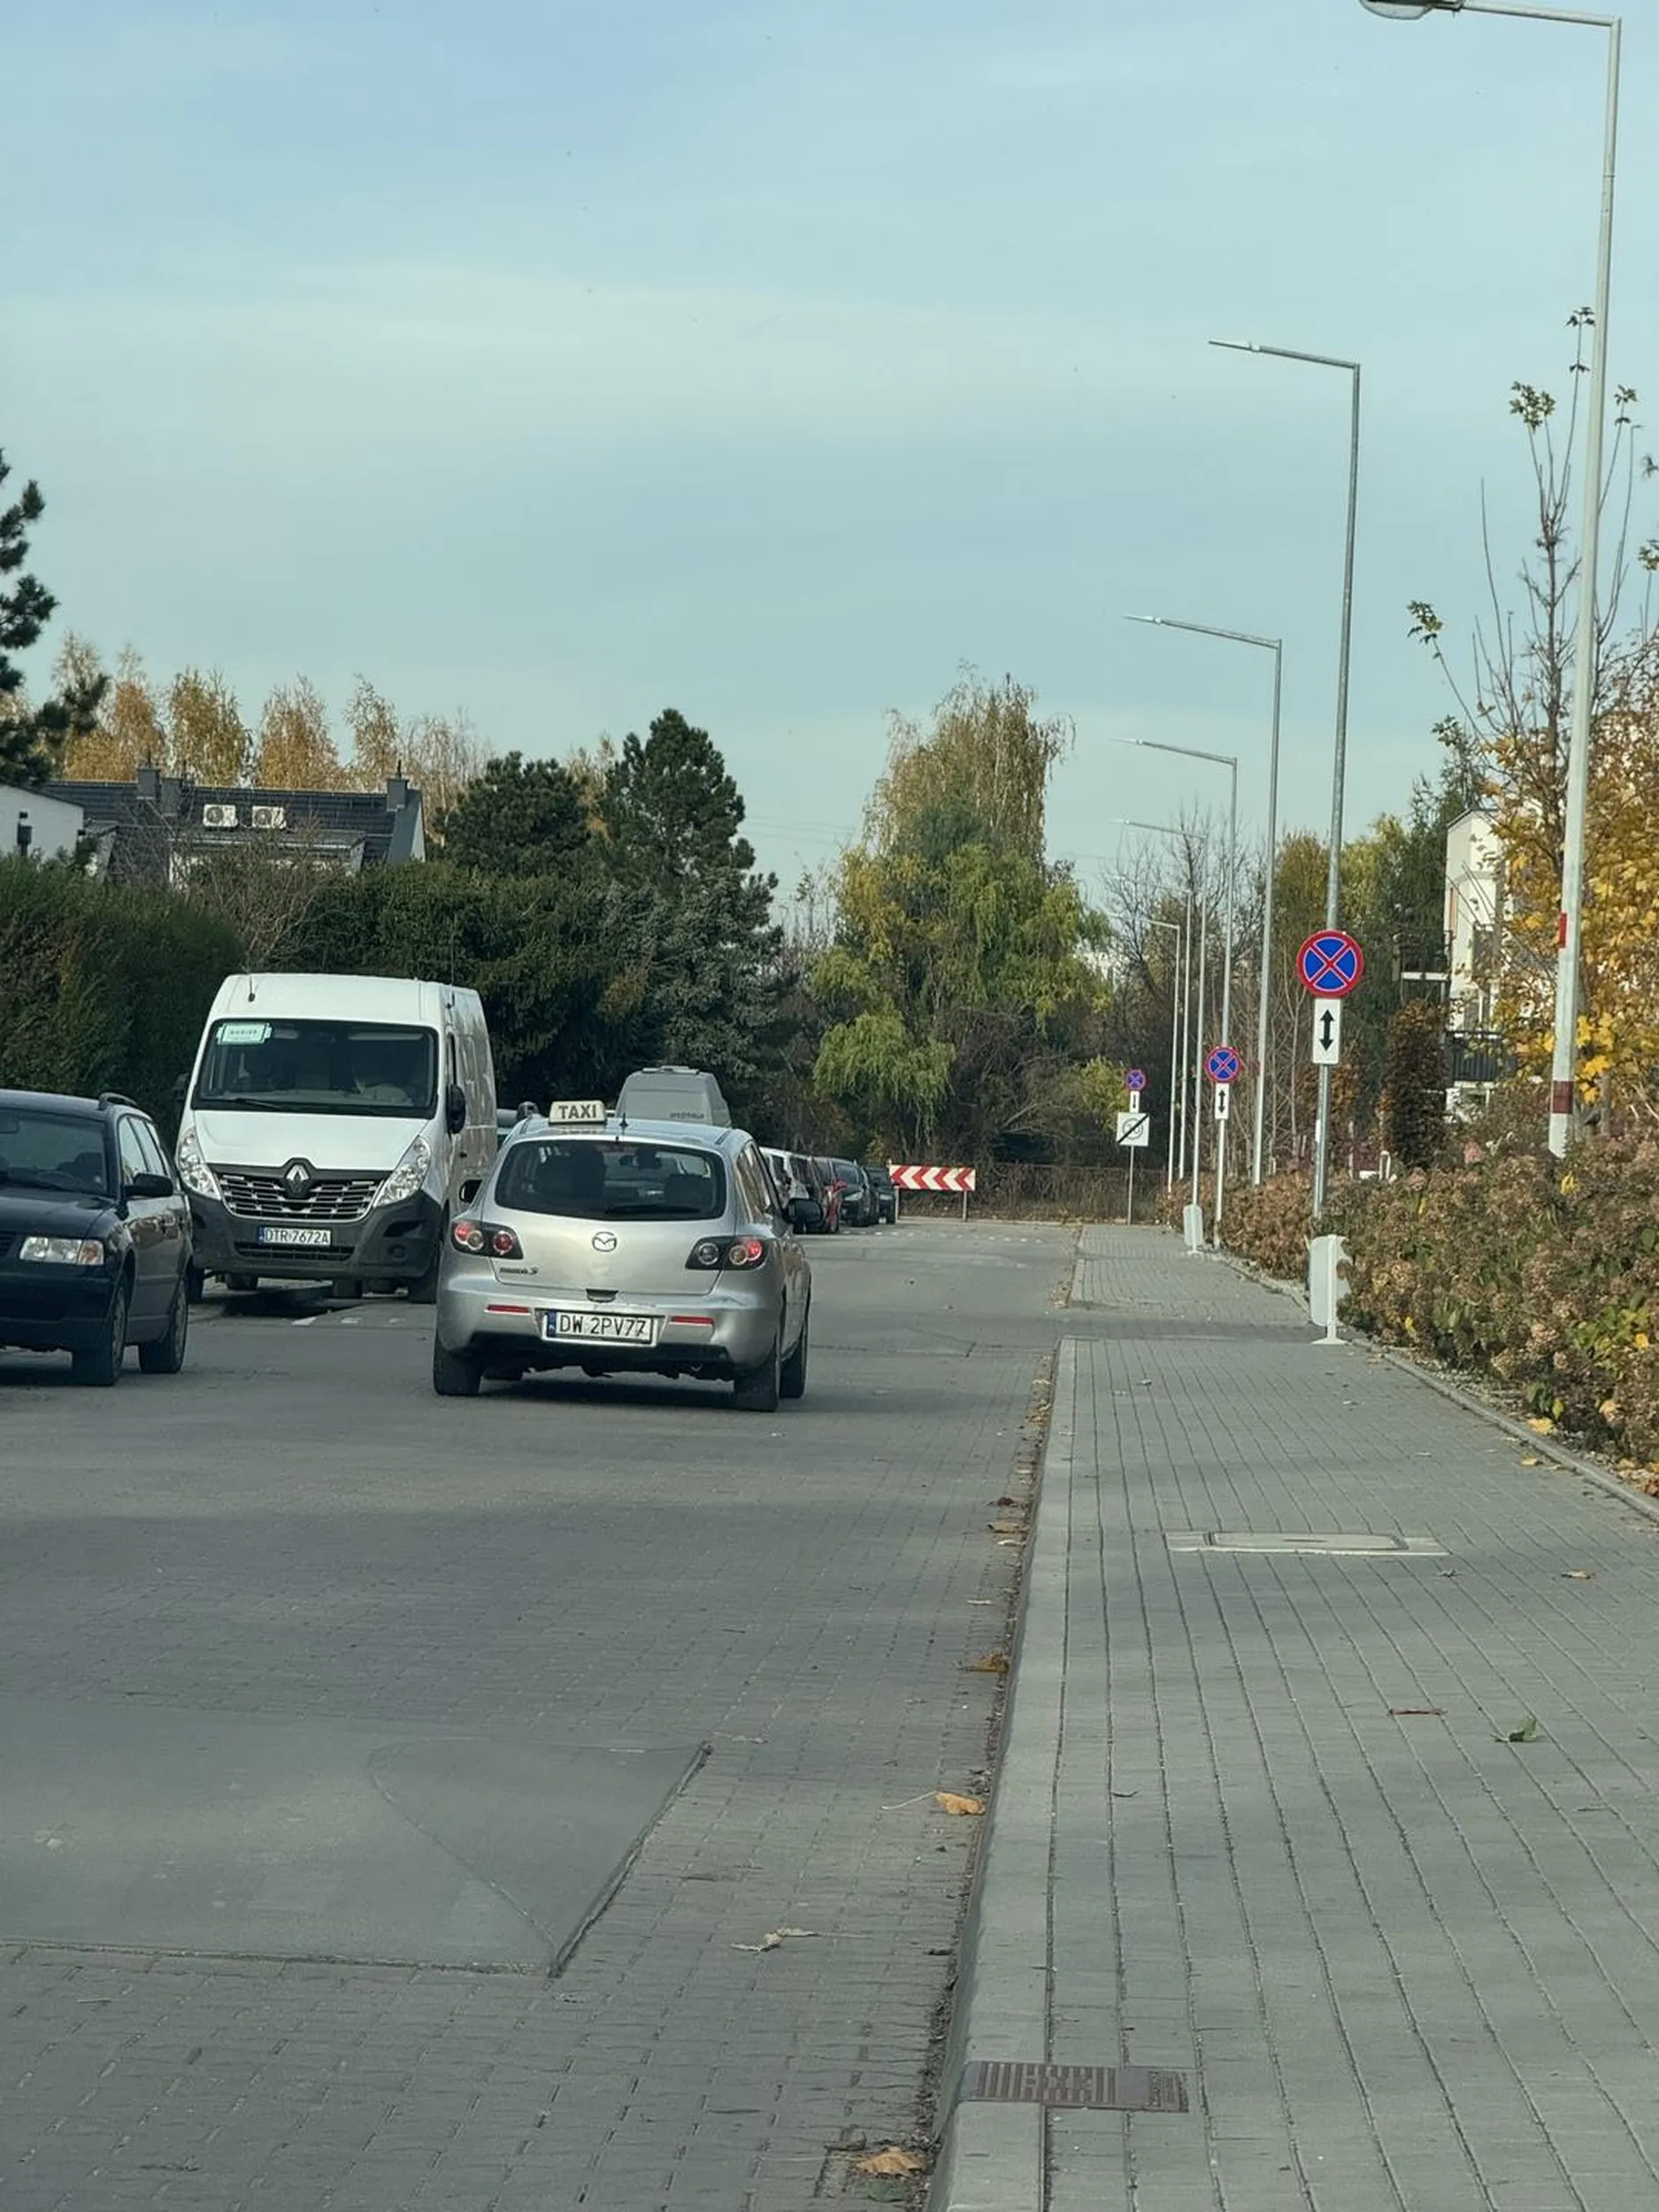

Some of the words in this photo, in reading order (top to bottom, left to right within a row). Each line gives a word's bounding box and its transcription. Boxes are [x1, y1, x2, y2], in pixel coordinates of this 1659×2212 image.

[557, 1104, 597, 1119] TAXI
[266, 1228, 288, 1242] DTR
[292, 1230, 329, 1243] 7672A
[560, 1314, 584, 1333] DW
[590, 1317, 647, 1337] 2PV77
